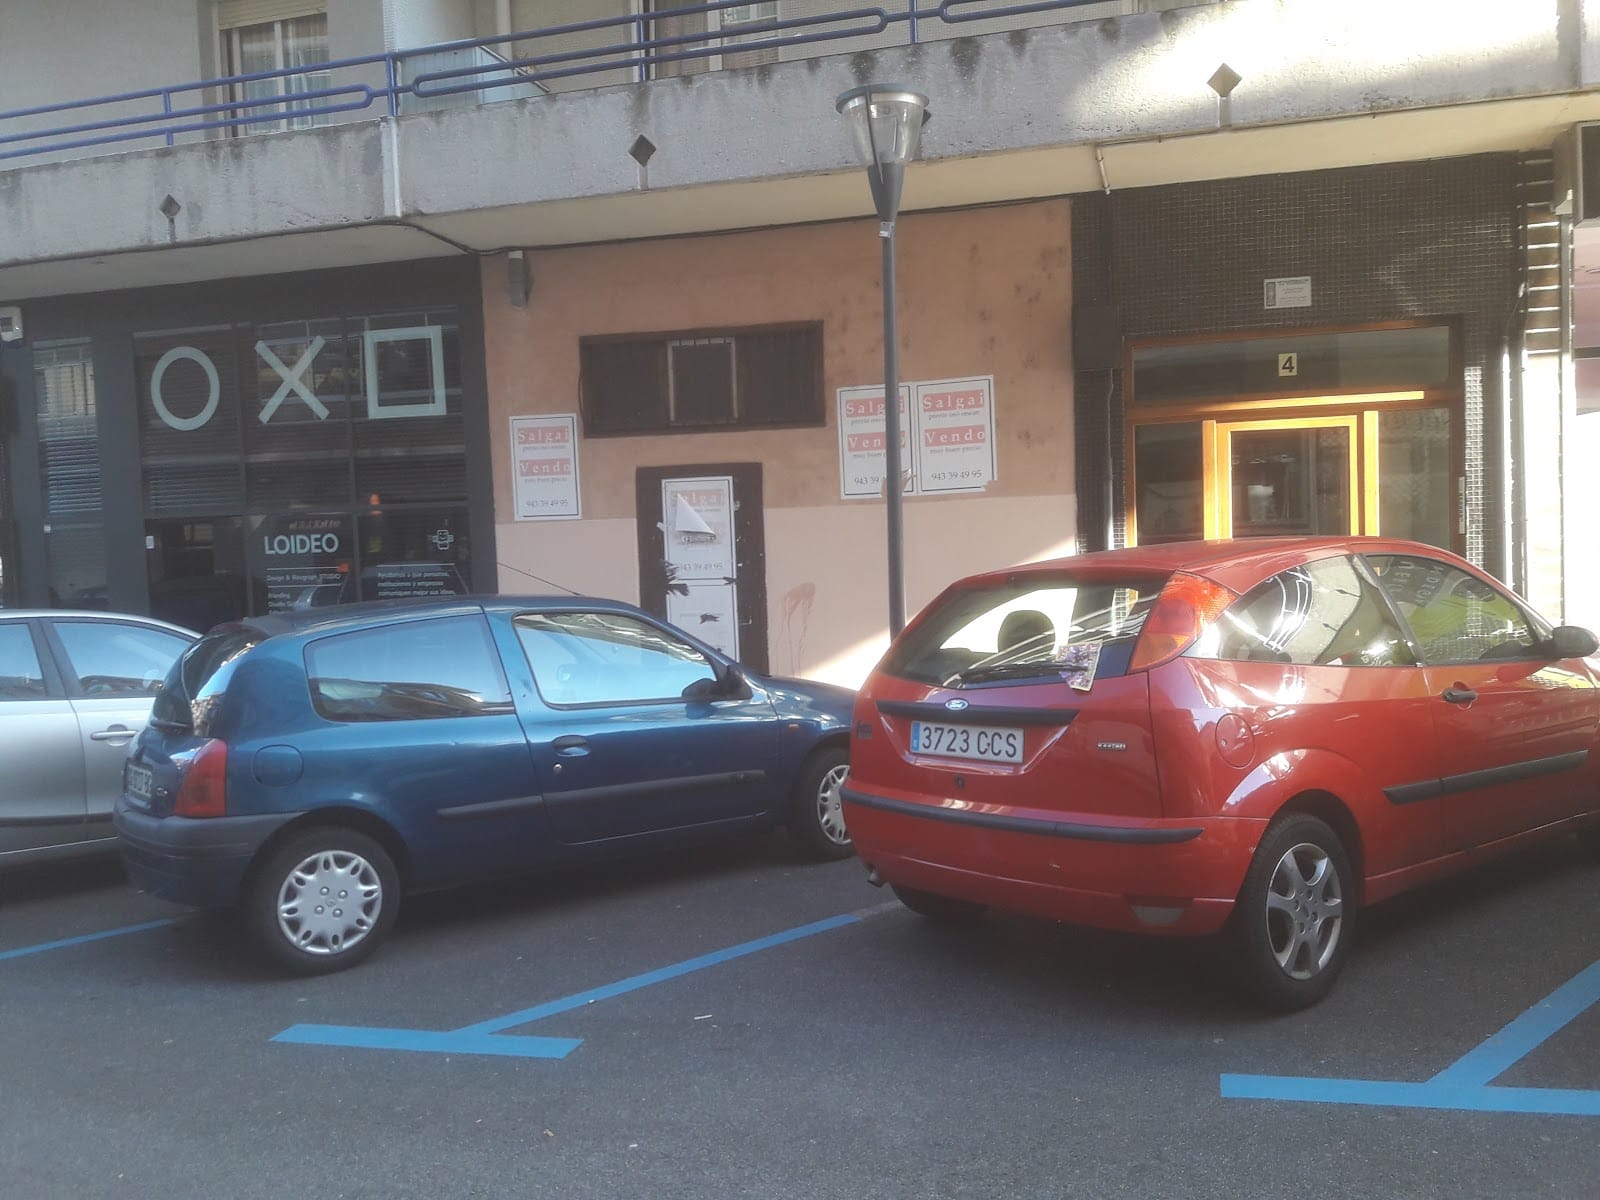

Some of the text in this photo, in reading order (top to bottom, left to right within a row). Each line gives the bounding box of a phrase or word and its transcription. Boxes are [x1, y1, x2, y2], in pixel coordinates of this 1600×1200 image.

[1282, 356, 1295, 373] 4
[847, 399, 903, 414] Salgi
[924, 392, 984, 409] Salgai
[518, 428, 569, 443] Salgai
[926, 429, 985, 444] Vendo
[519, 460, 571, 474] Vendo
[854, 476, 868, 485] 943
[931, 469, 982, 481] 943 39 49 95
[264, 533, 339, 554] LOIDEO
[922, 726, 1018, 758] 3723 CCS
